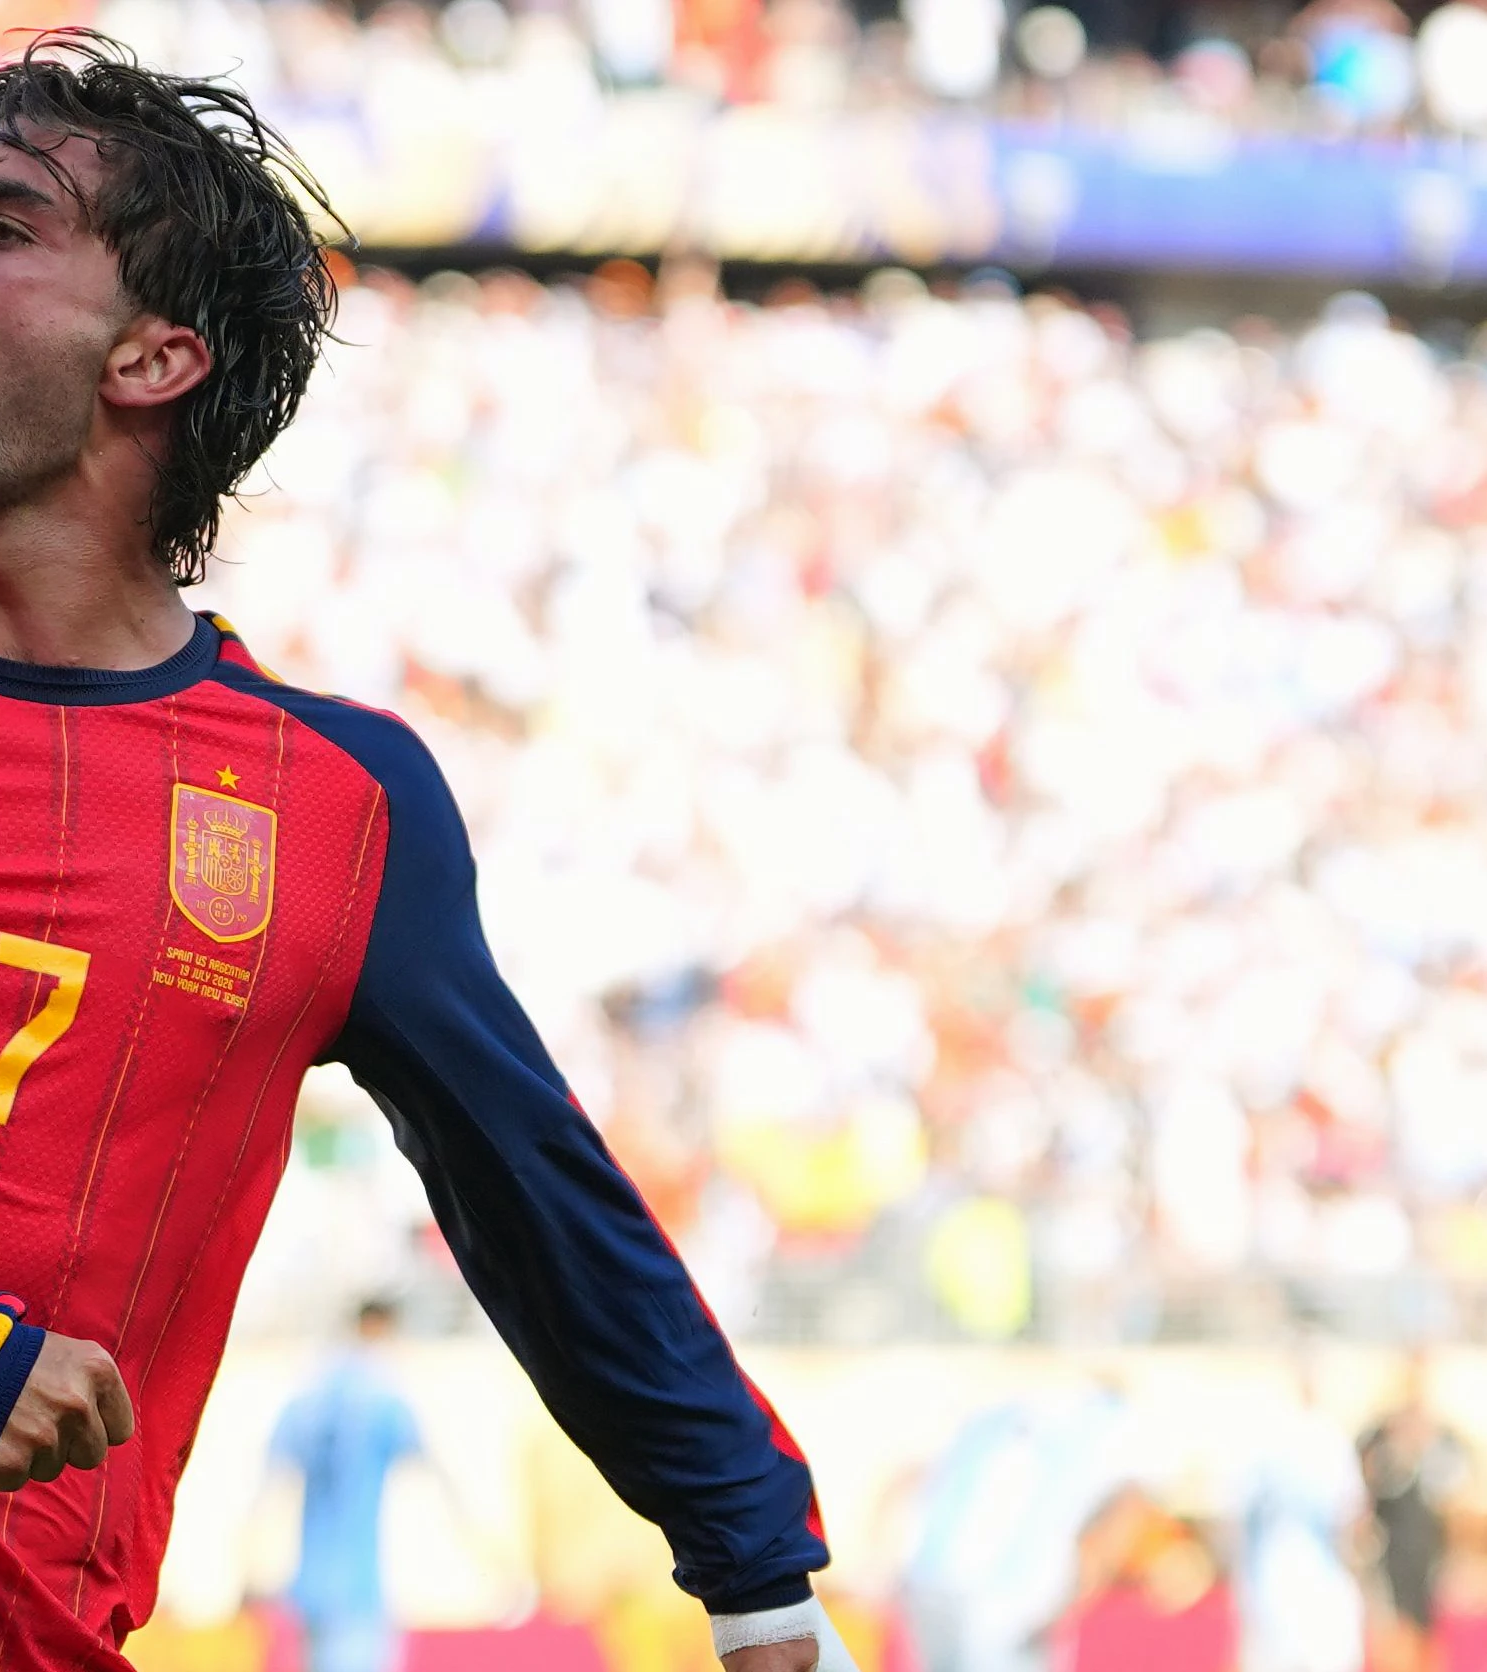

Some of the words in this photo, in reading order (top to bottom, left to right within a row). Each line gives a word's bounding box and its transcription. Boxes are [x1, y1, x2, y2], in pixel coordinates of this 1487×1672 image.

[166, 946, 193, 963] SPAIN
[209, 958, 251, 982] ARGENTINA
[179, 964, 190, 977] 19
[191, 967, 211, 983] JULY
[212, 973, 234, 991] 2026
[152, 969, 175, 986] NEW
[200, 984, 222, 1001] NEW
